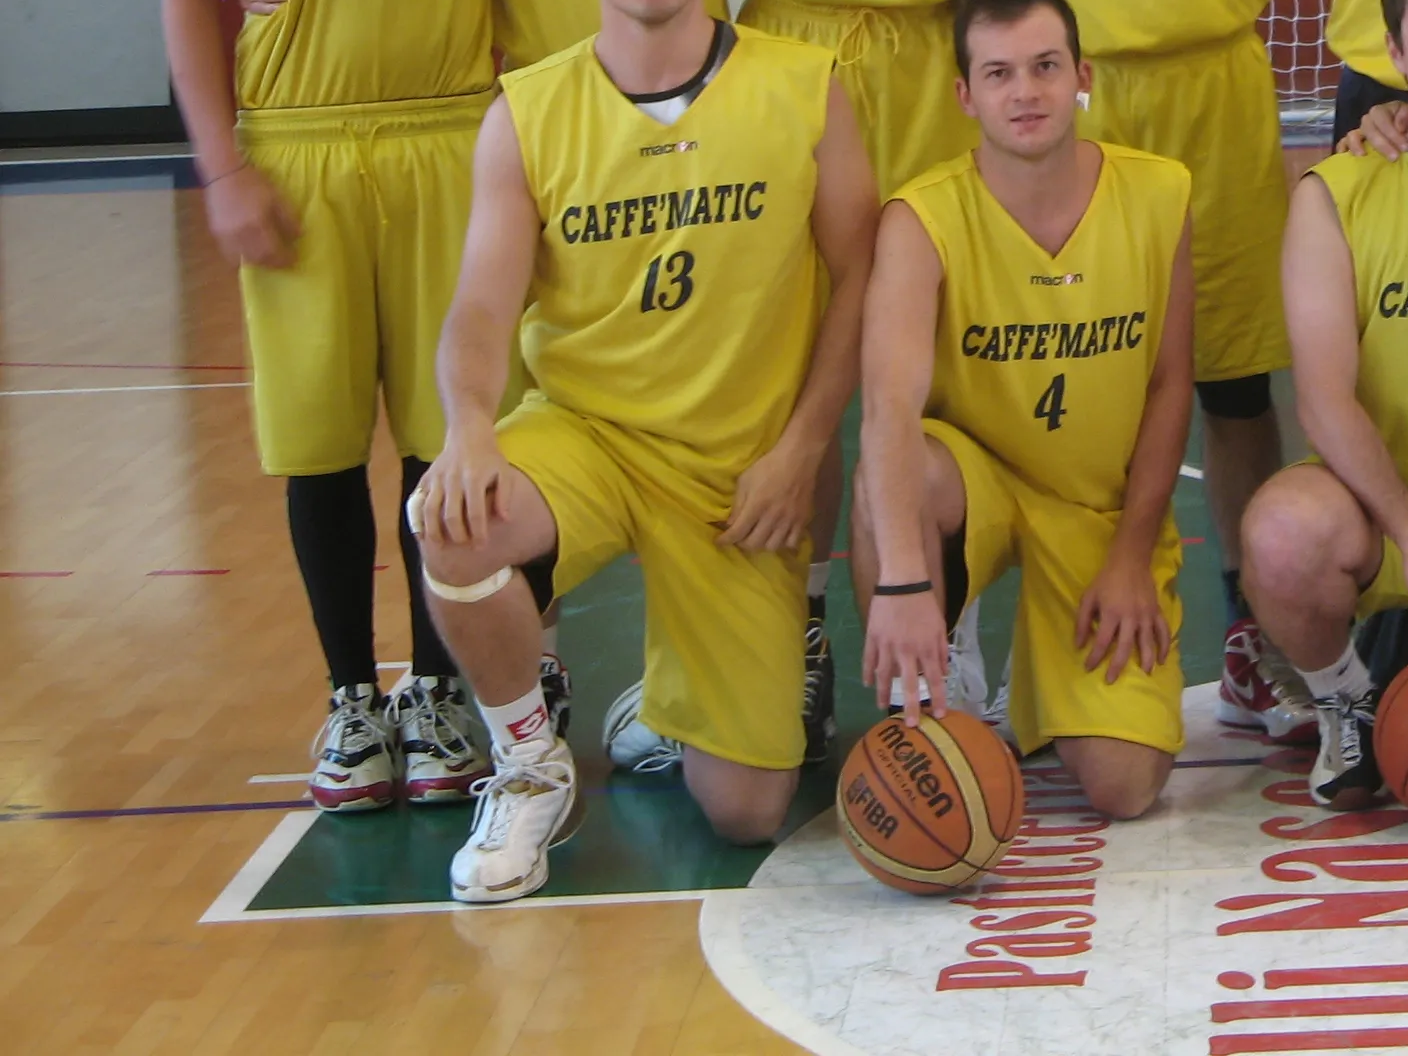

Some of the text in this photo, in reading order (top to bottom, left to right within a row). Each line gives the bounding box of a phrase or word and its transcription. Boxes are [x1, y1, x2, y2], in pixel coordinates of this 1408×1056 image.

[639, 141, 697, 157] macron
[561, 181, 767, 245] CAFFE'MATIC
[640, 250, 695, 314] 13
[1030, 273, 1083, 286] macron
[961, 311, 1146, 362] CAFFE'MATIC
[1034, 373, 1067, 432] 4
[877, 749, 917, 803] OFFICIAL
[878, 724, 953, 818] molten
[855, 786, 897, 839] FIBA
